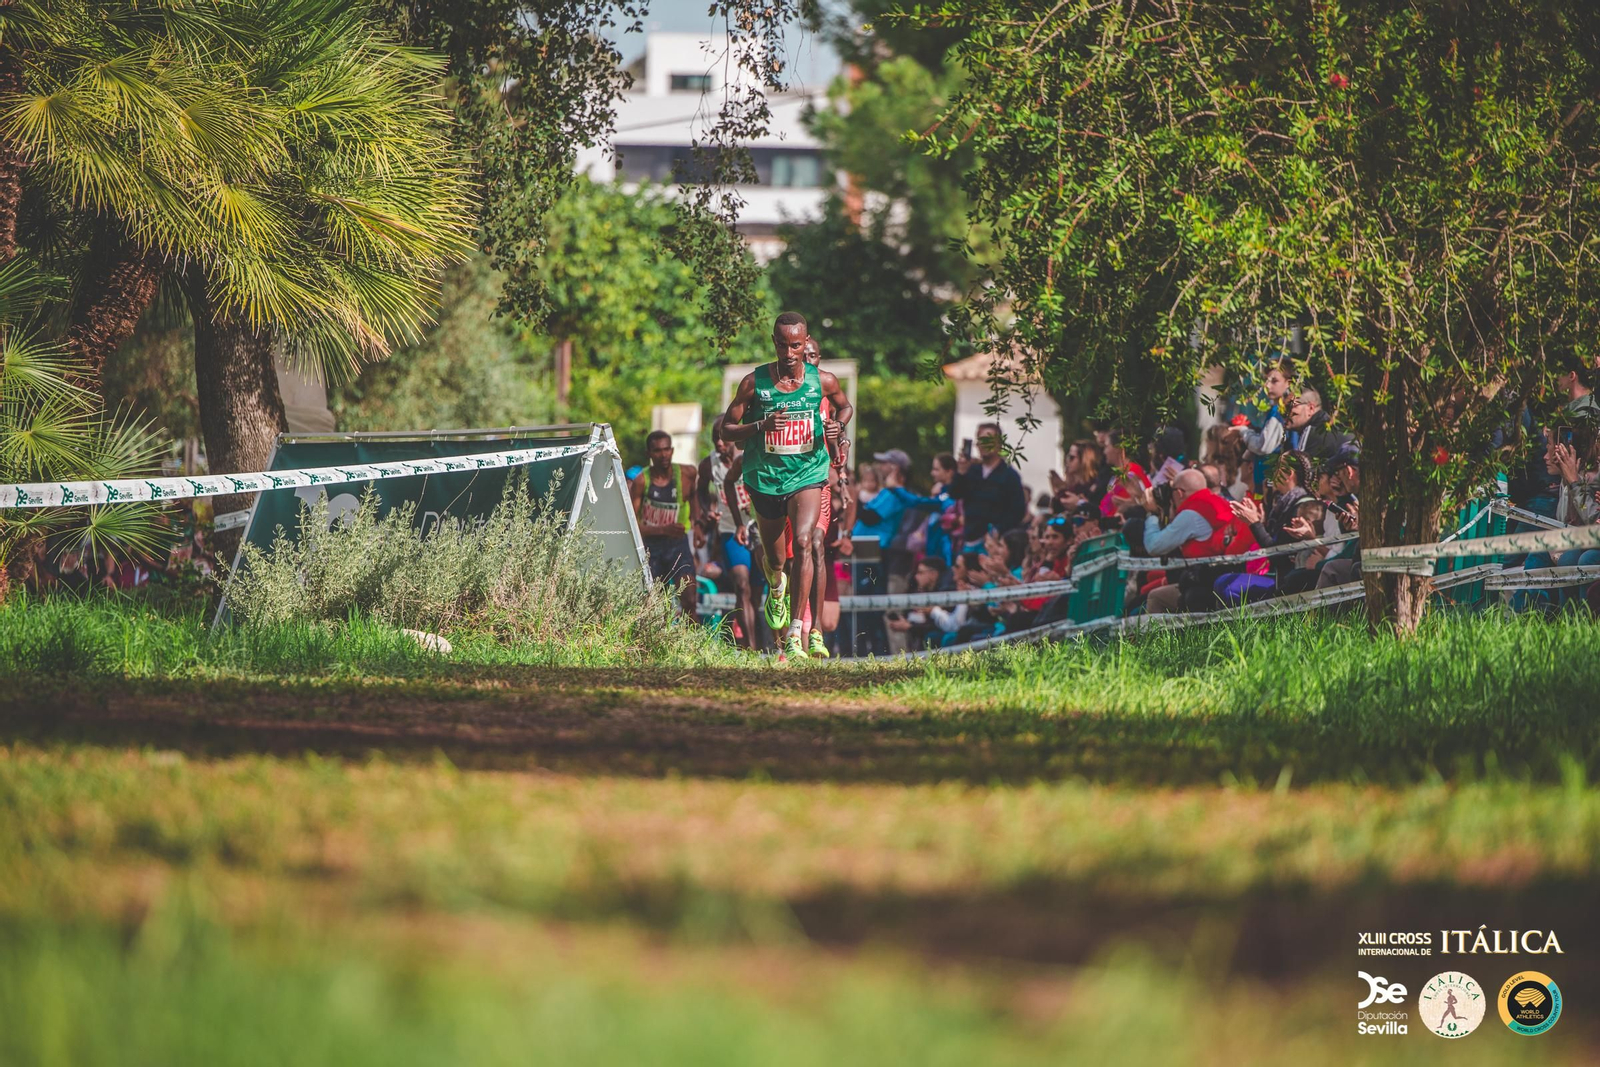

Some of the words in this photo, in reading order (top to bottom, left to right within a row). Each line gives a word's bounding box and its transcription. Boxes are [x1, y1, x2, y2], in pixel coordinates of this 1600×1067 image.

[74, 494, 89, 502] Sevilla
[119, 492, 133, 500] Sevilla
[162, 488, 177, 497] Sevilla
[204, 485, 219, 494] Sevilla
[244, 480, 258, 490] Sevilla
